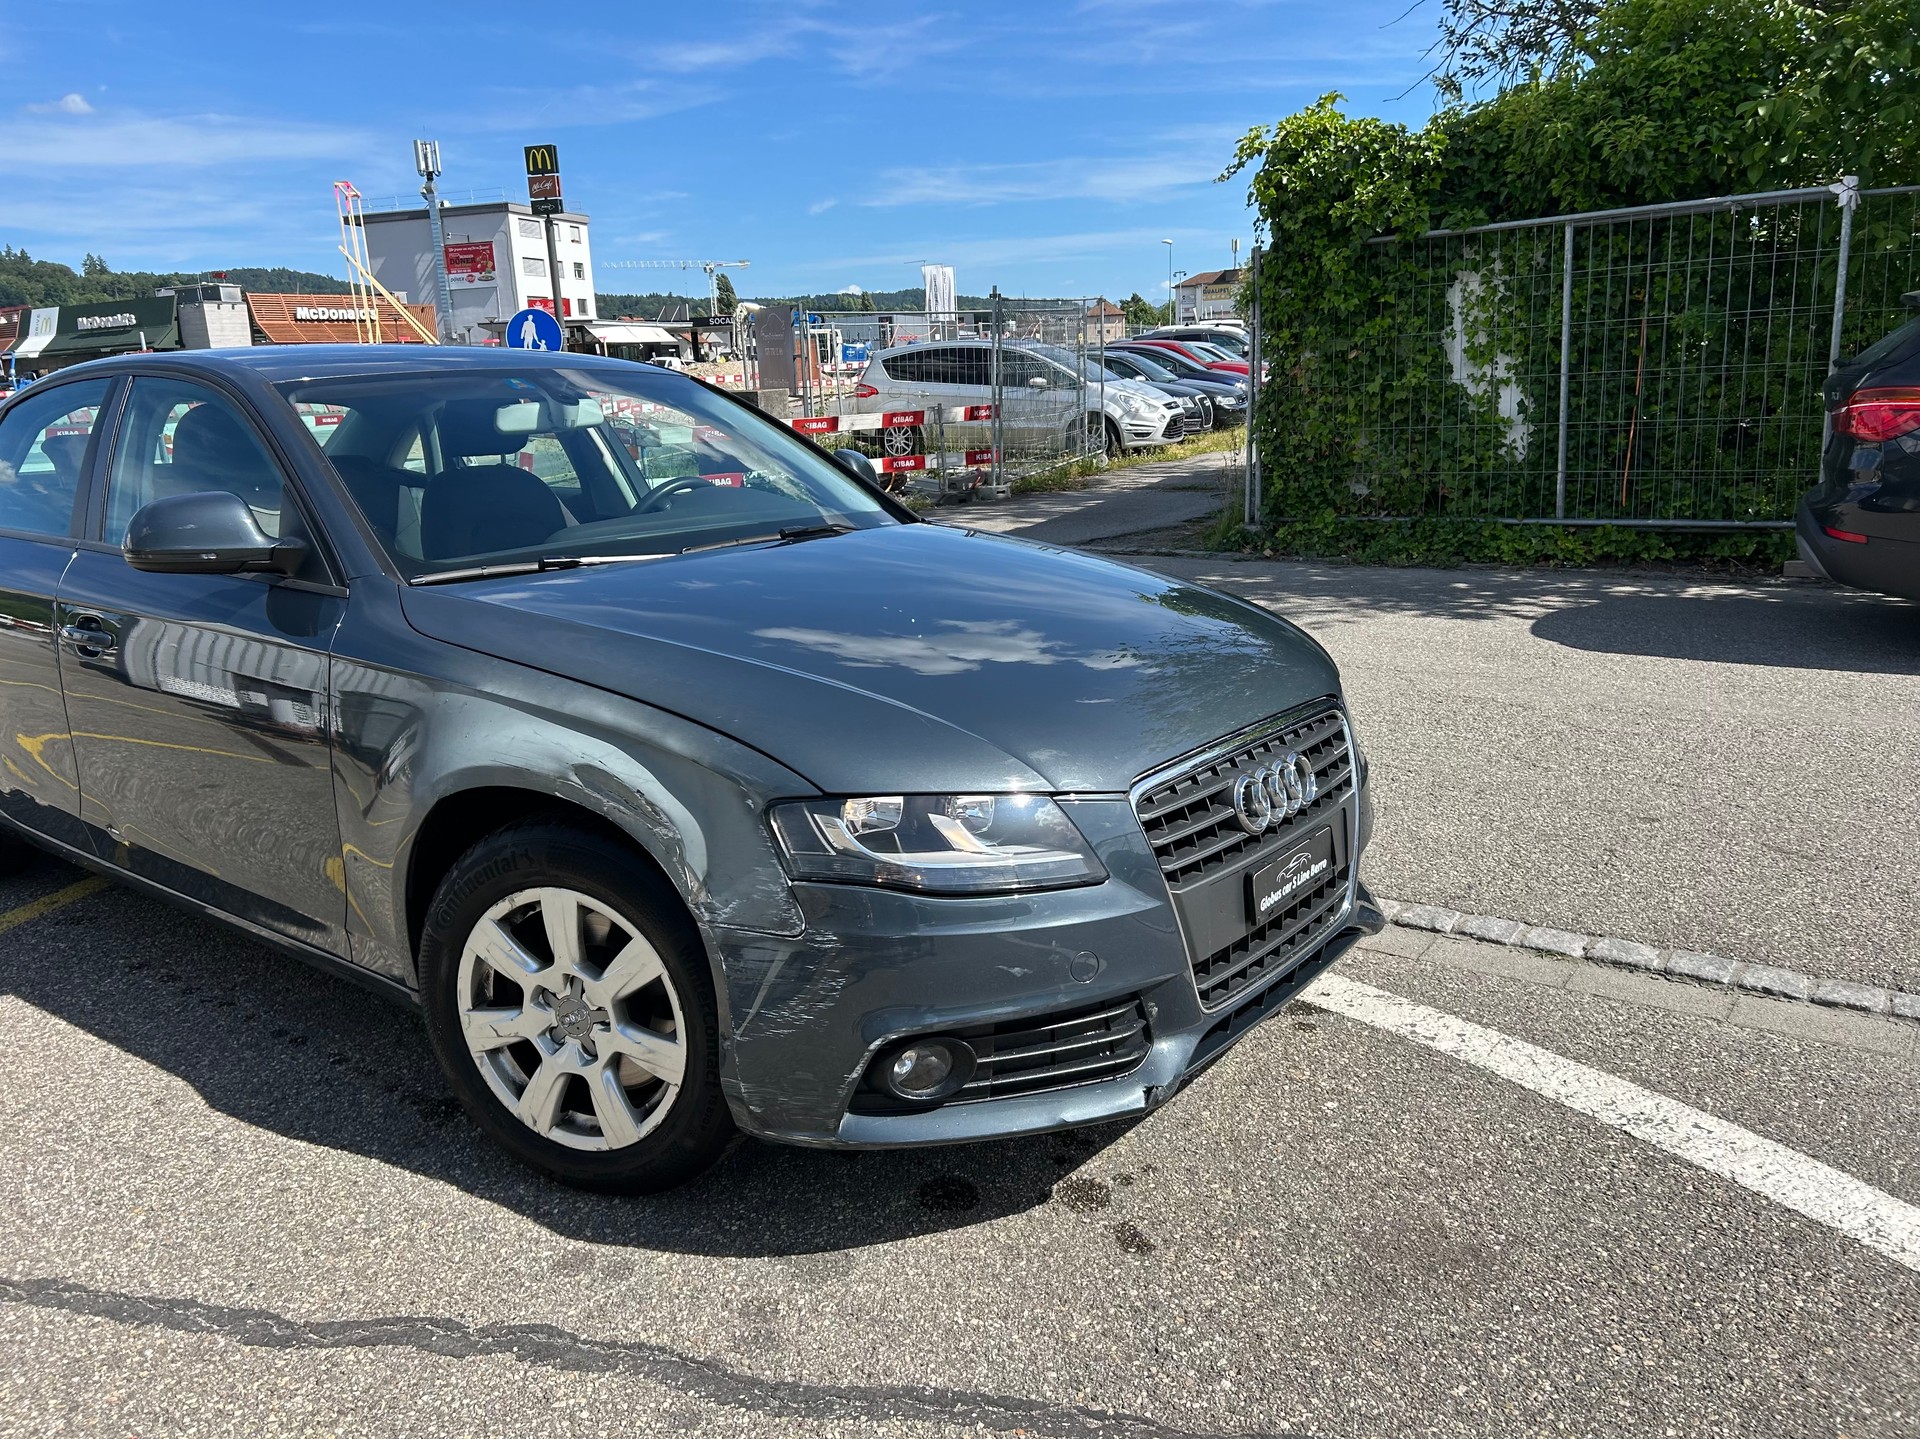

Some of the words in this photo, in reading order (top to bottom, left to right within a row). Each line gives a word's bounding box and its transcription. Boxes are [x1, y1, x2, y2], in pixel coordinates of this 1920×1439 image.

[77, 312, 137, 330] McDonald's
[893, 414, 914, 424] KIBAG
[893, 459, 915, 468] KIBAG
[436, 850, 518, 930] Continental
[1260, 888, 1282, 912] Globus
[1282, 882, 1292, 896] car
[1292, 876, 1297, 889] S
[1297, 869, 1310, 886] Line
